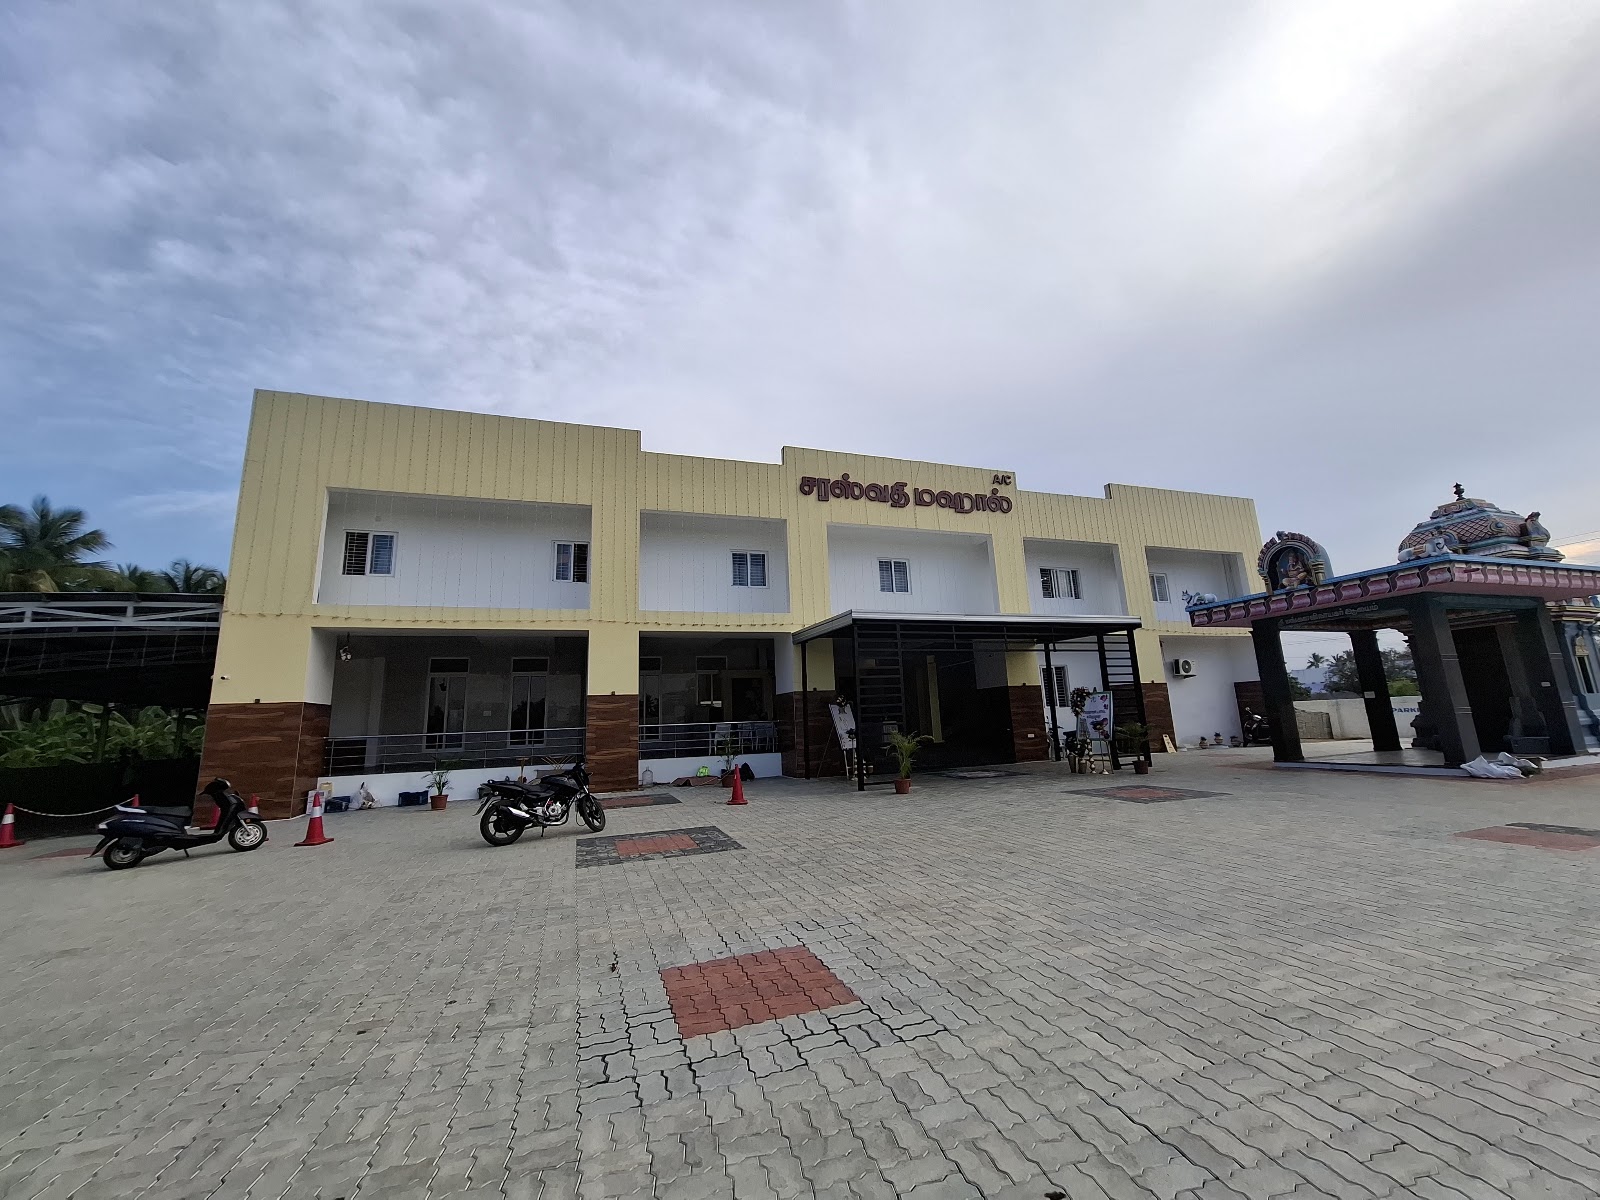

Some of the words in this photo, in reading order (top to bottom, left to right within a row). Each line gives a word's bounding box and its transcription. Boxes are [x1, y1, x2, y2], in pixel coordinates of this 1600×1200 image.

[992, 474, 1011, 485] A/C
[800, 473, 910, 508] சரஸ்வதி
[914, 488, 1012, 513] மஹால்
